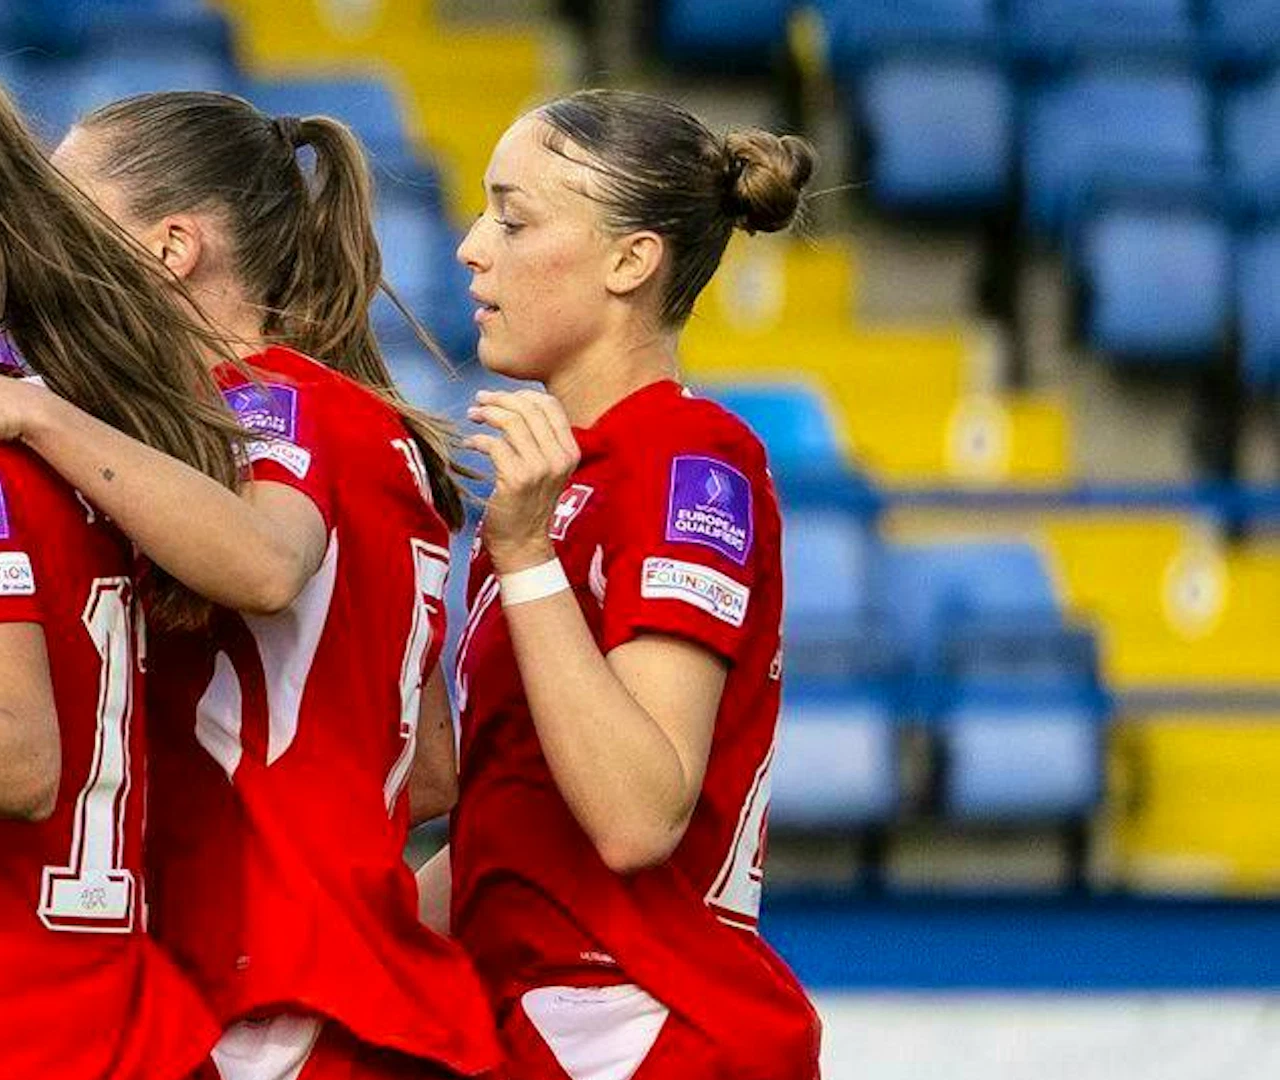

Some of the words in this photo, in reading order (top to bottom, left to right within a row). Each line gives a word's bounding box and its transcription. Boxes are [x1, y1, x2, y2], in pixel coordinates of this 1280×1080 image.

[674, 518, 745, 552] QUALIFIERS
[676, 508, 747, 538] EUROPEAN
[646, 569, 744, 612] FOUNDATION
